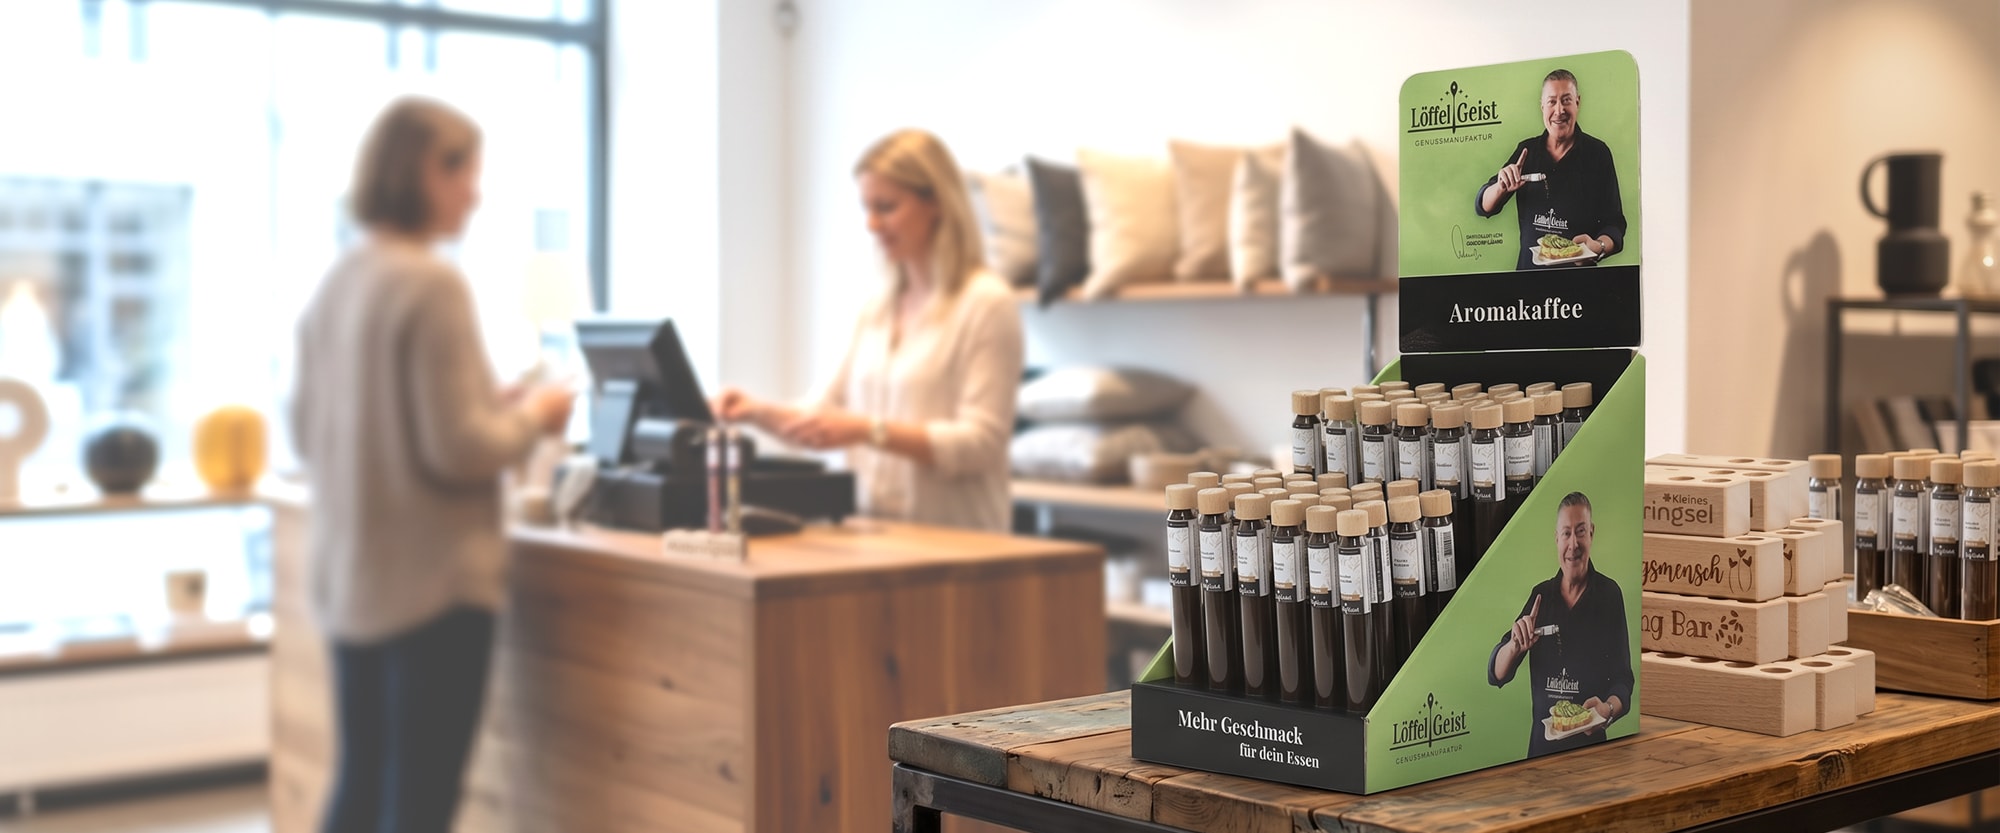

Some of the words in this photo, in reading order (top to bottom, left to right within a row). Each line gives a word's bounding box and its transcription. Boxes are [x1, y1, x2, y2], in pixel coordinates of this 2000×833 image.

[1411, 104, 1450, 128] Löffel
[1457, 99, 1499, 123] Geist
[1414, 133, 1493, 147] GENUSSMANUFAKTUR
[1449, 297, 1583, 324] Aromakaffee
[1672, 494, 1708, 506] Kleines
[1671, 610, 1712, 639] Bar
[1177, 709, 1218, 733] Mehr
[1221, 715, 1303, 746] Geschmack
[1392, 717, 1428, 745] Löffel
[1433, 710, 1467, 736] Geist
[1239, 742, 1257, 759] für
[1258, 745, 1284, 763] dein
[1286, 750, 1320, 769] Essen
